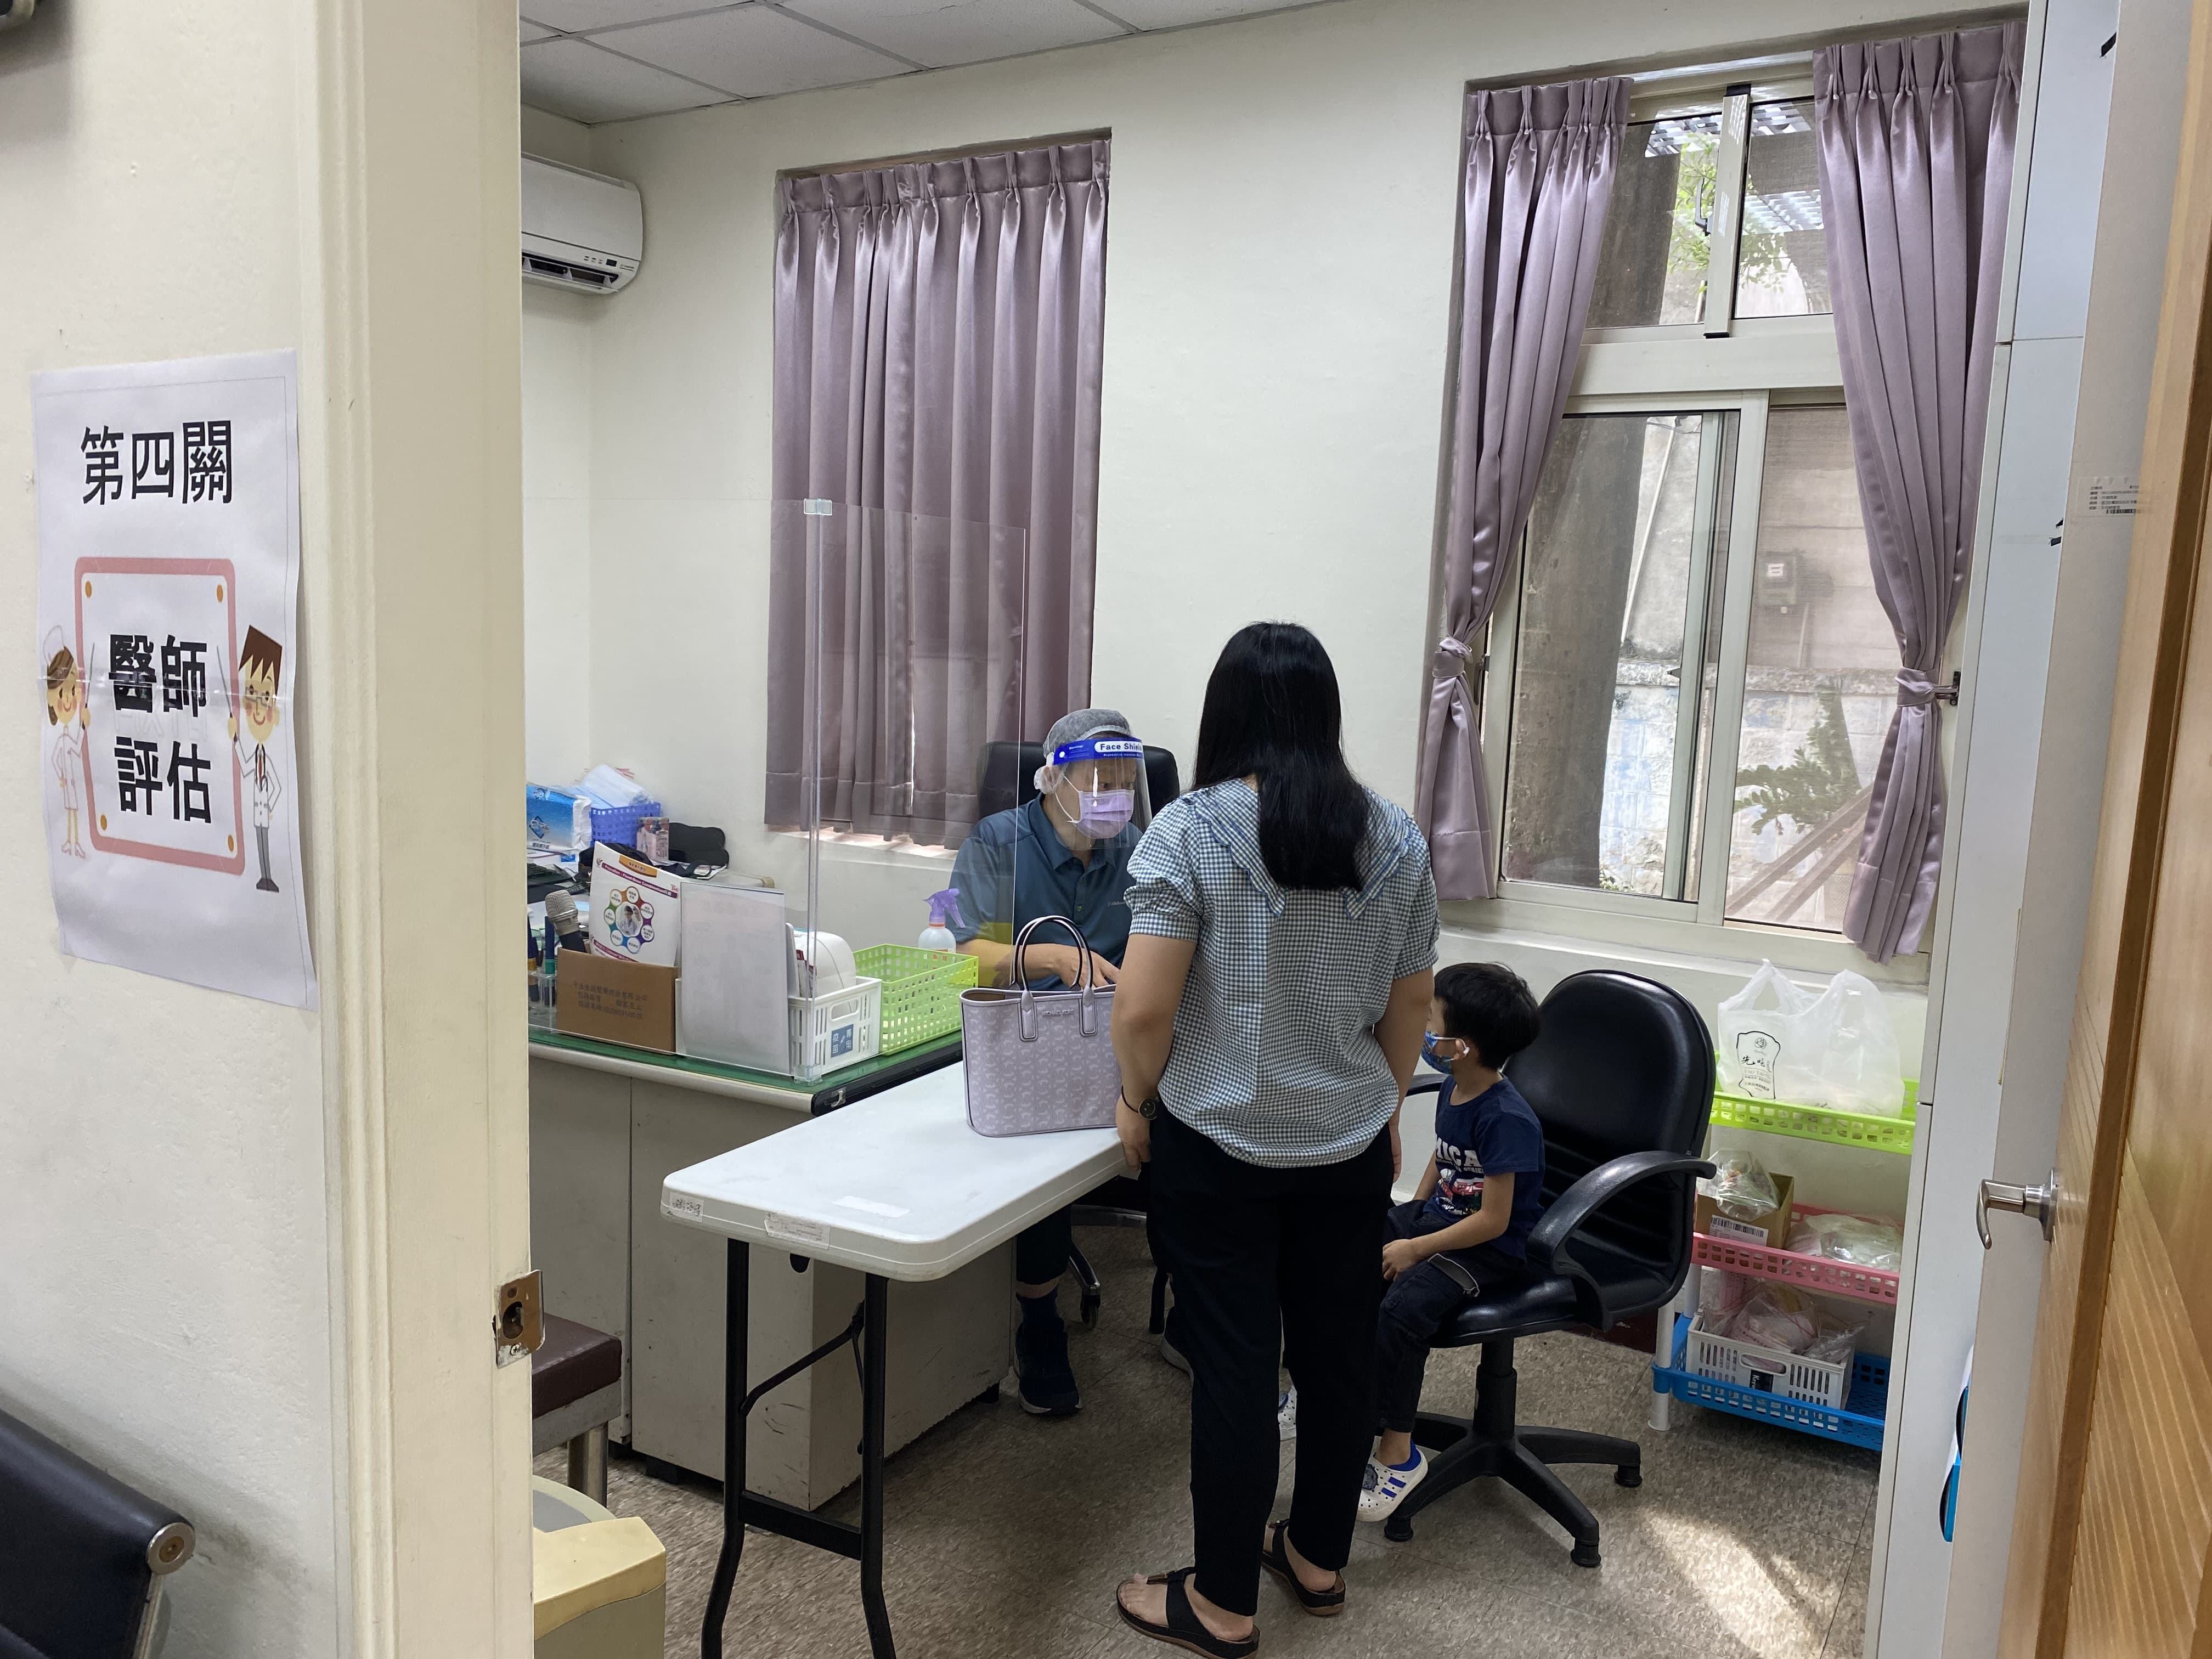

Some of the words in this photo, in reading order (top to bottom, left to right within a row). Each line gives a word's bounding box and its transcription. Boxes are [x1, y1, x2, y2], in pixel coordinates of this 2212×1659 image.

[81, 420, 233, 505] 第四關
[109, 634, 207, 718] 醫師
[114, 736, 211, 824] 評估
[1124, 743, 1142, 751] Shield
